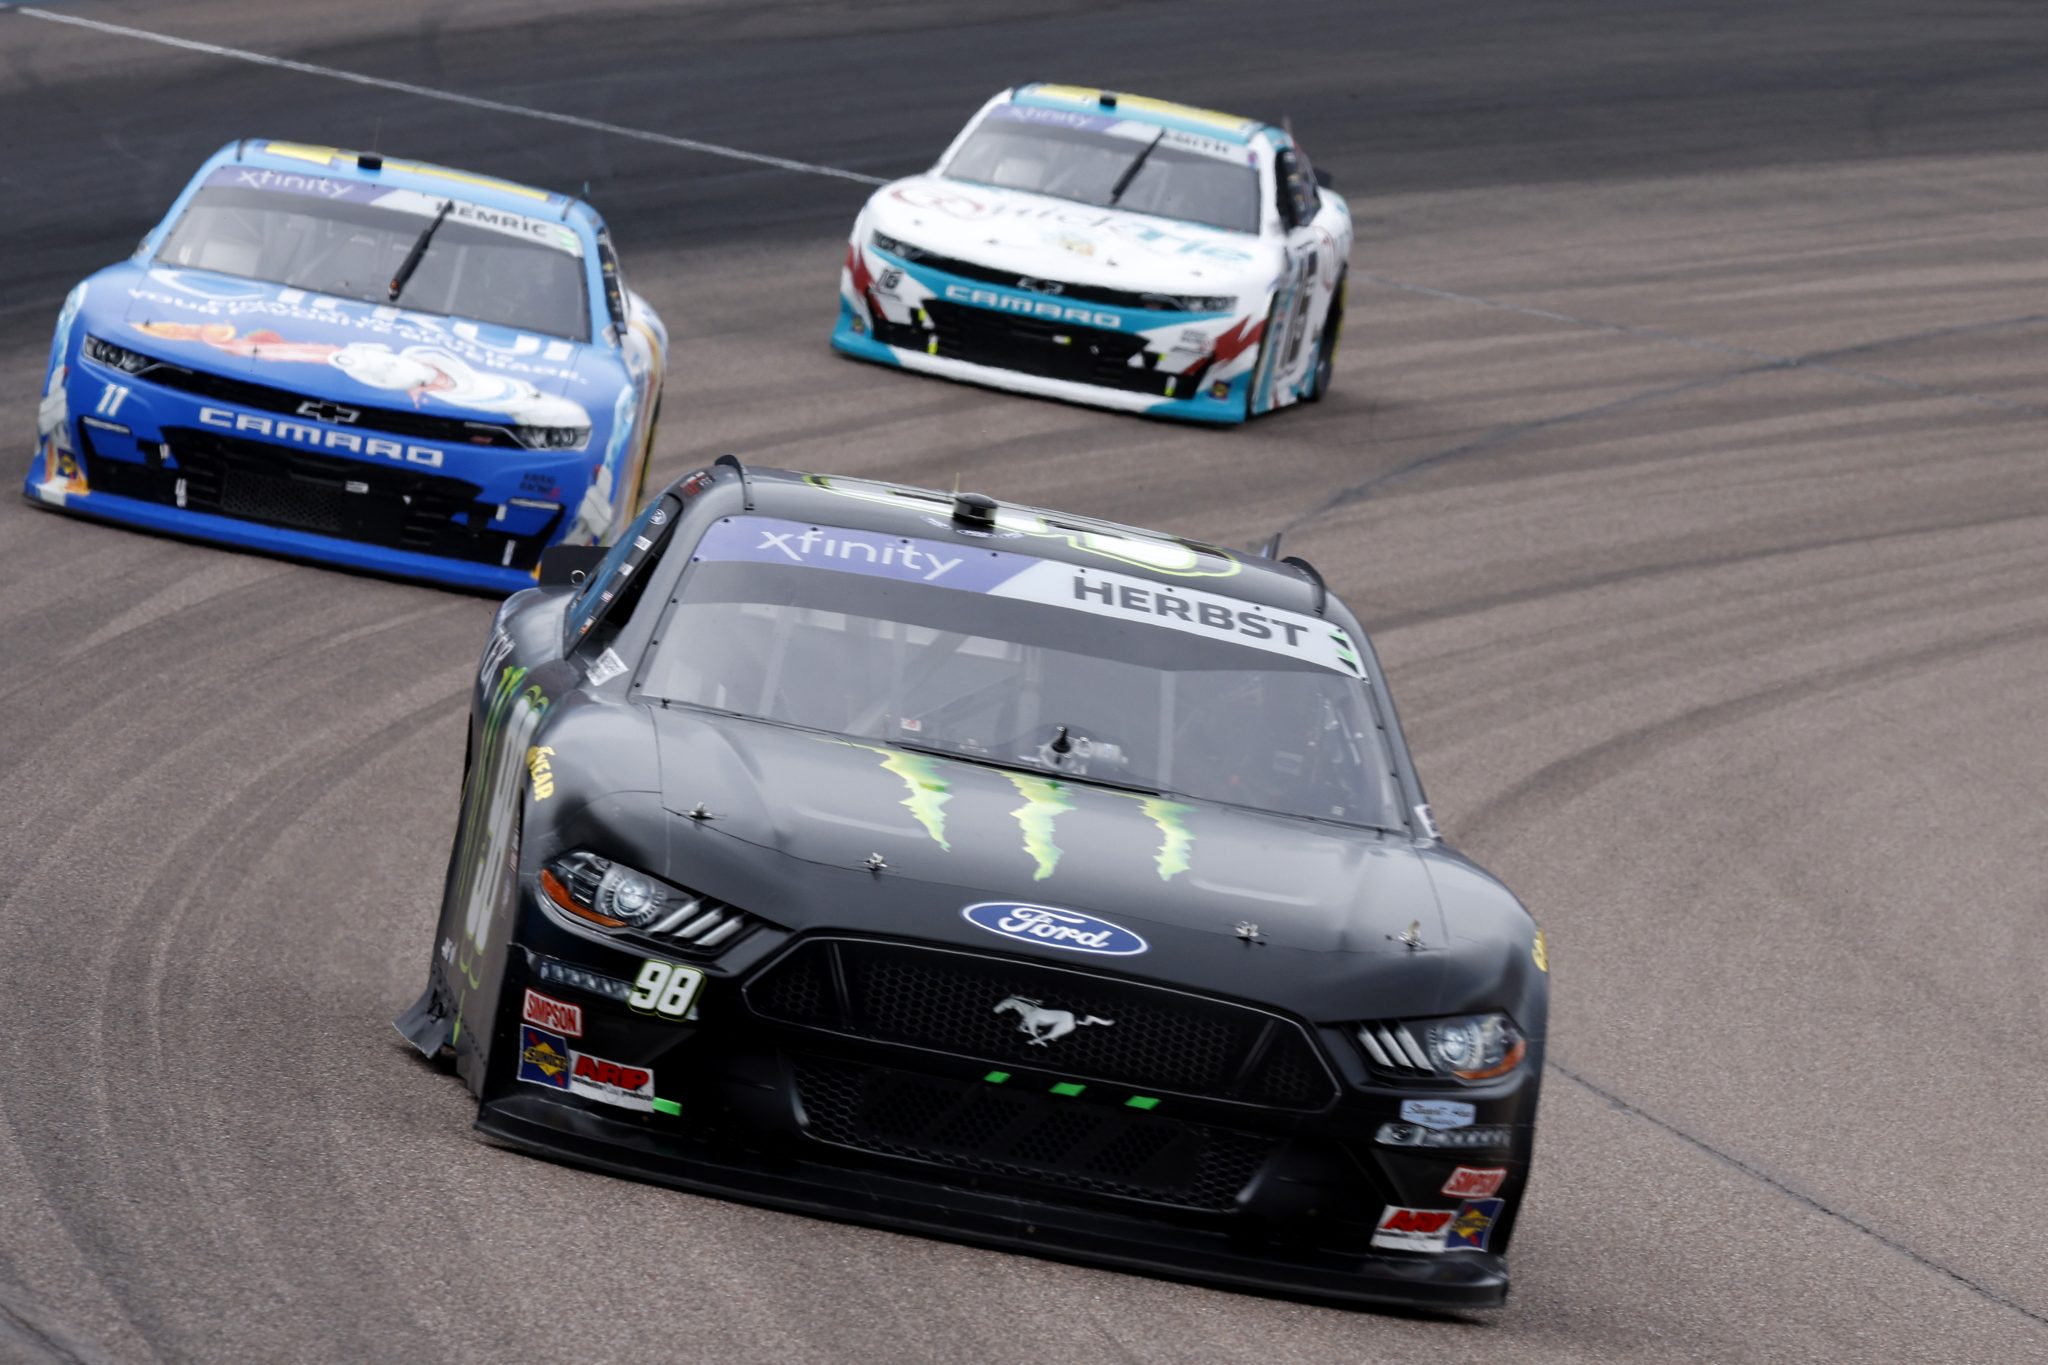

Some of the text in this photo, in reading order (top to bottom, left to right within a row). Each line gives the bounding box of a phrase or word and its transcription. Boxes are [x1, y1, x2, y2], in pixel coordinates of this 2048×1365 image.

[236, 168, 355, 200] xfinity
[944, 284, 1122, 330] CAMARO
[96, 382, 130, 417] 11
[198, 406, 444, 469] CAMARO
[756, 527, 966, 581] xfinity
[1072, 574, 1309, 649] HERBST
[998, 906, 1114, 949] Ford
[629, 959, 704, 1019] 98
[526, 992, 579, 1033] SIMPSON
[572, 1054, 650, 1092] ARP
